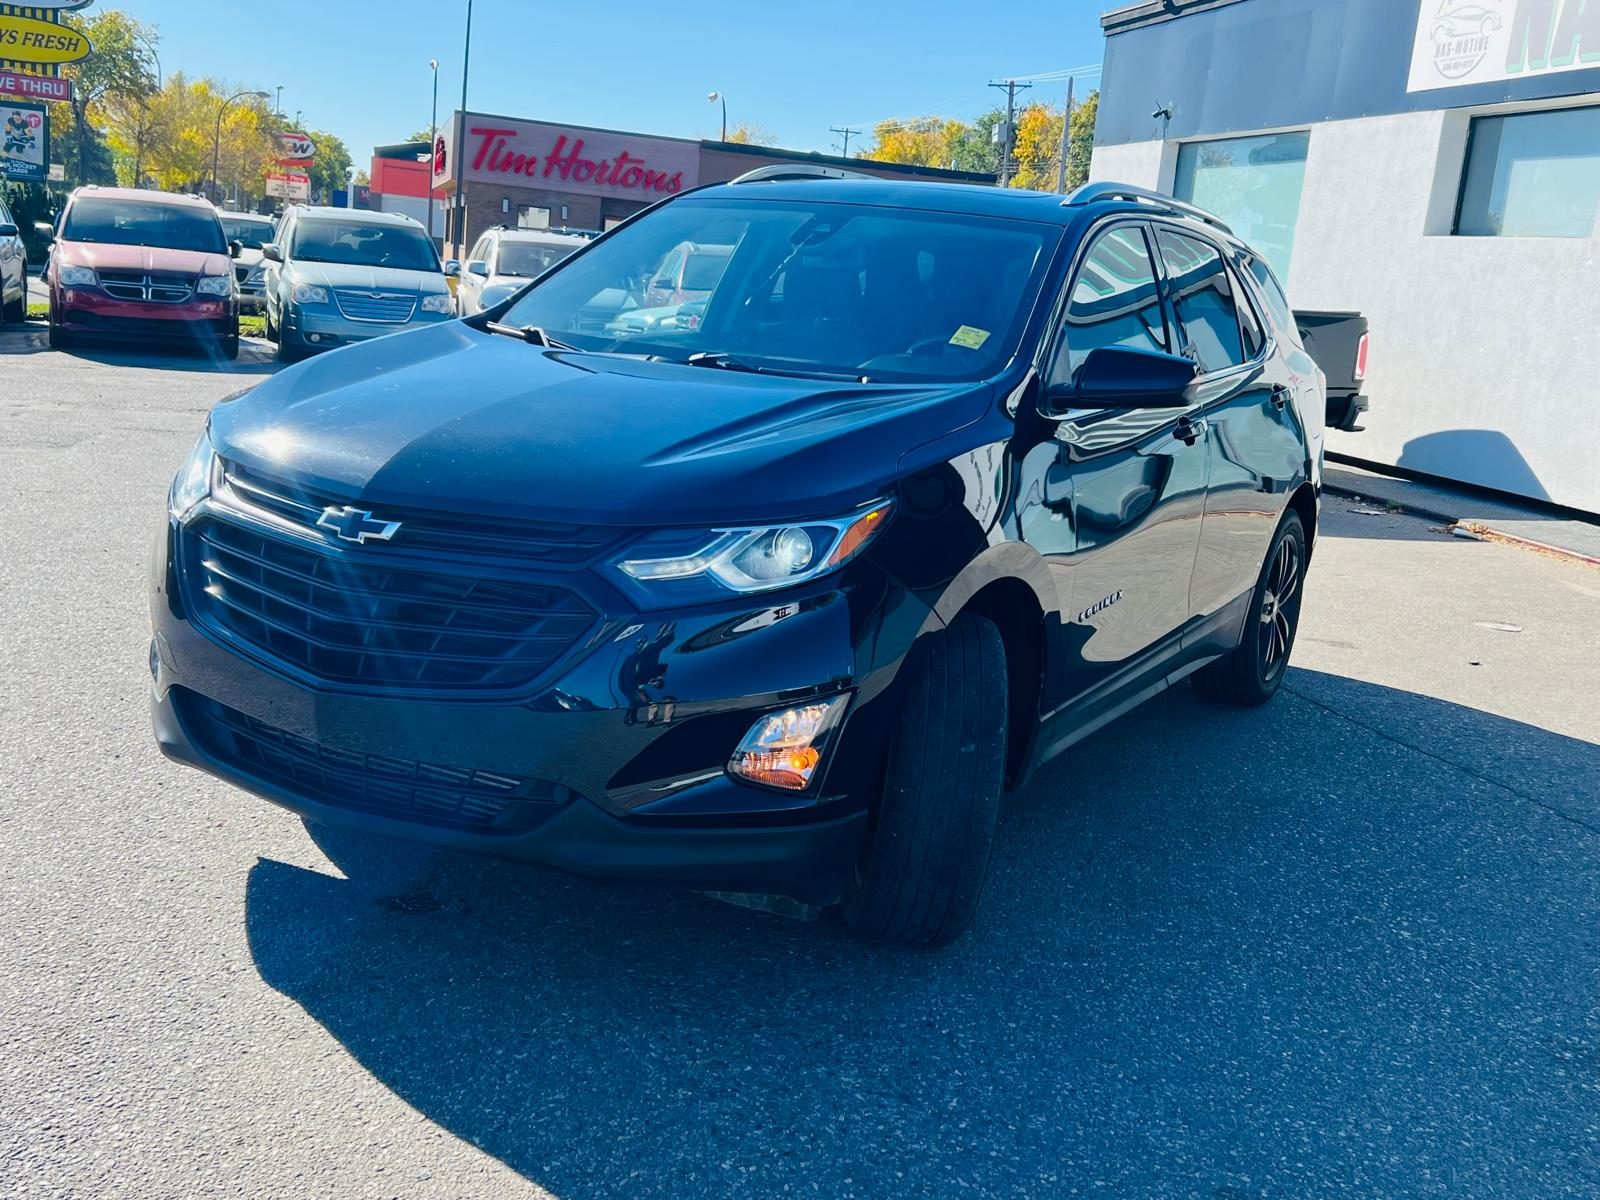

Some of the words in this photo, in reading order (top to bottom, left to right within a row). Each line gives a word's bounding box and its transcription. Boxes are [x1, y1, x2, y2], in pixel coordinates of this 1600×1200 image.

[22, 32, 80, 52] FRESH
[20, 79, 64, 96] THRU
[471, 128, 537, 177] Tim
[544, 134, 684, 193] Hortons
